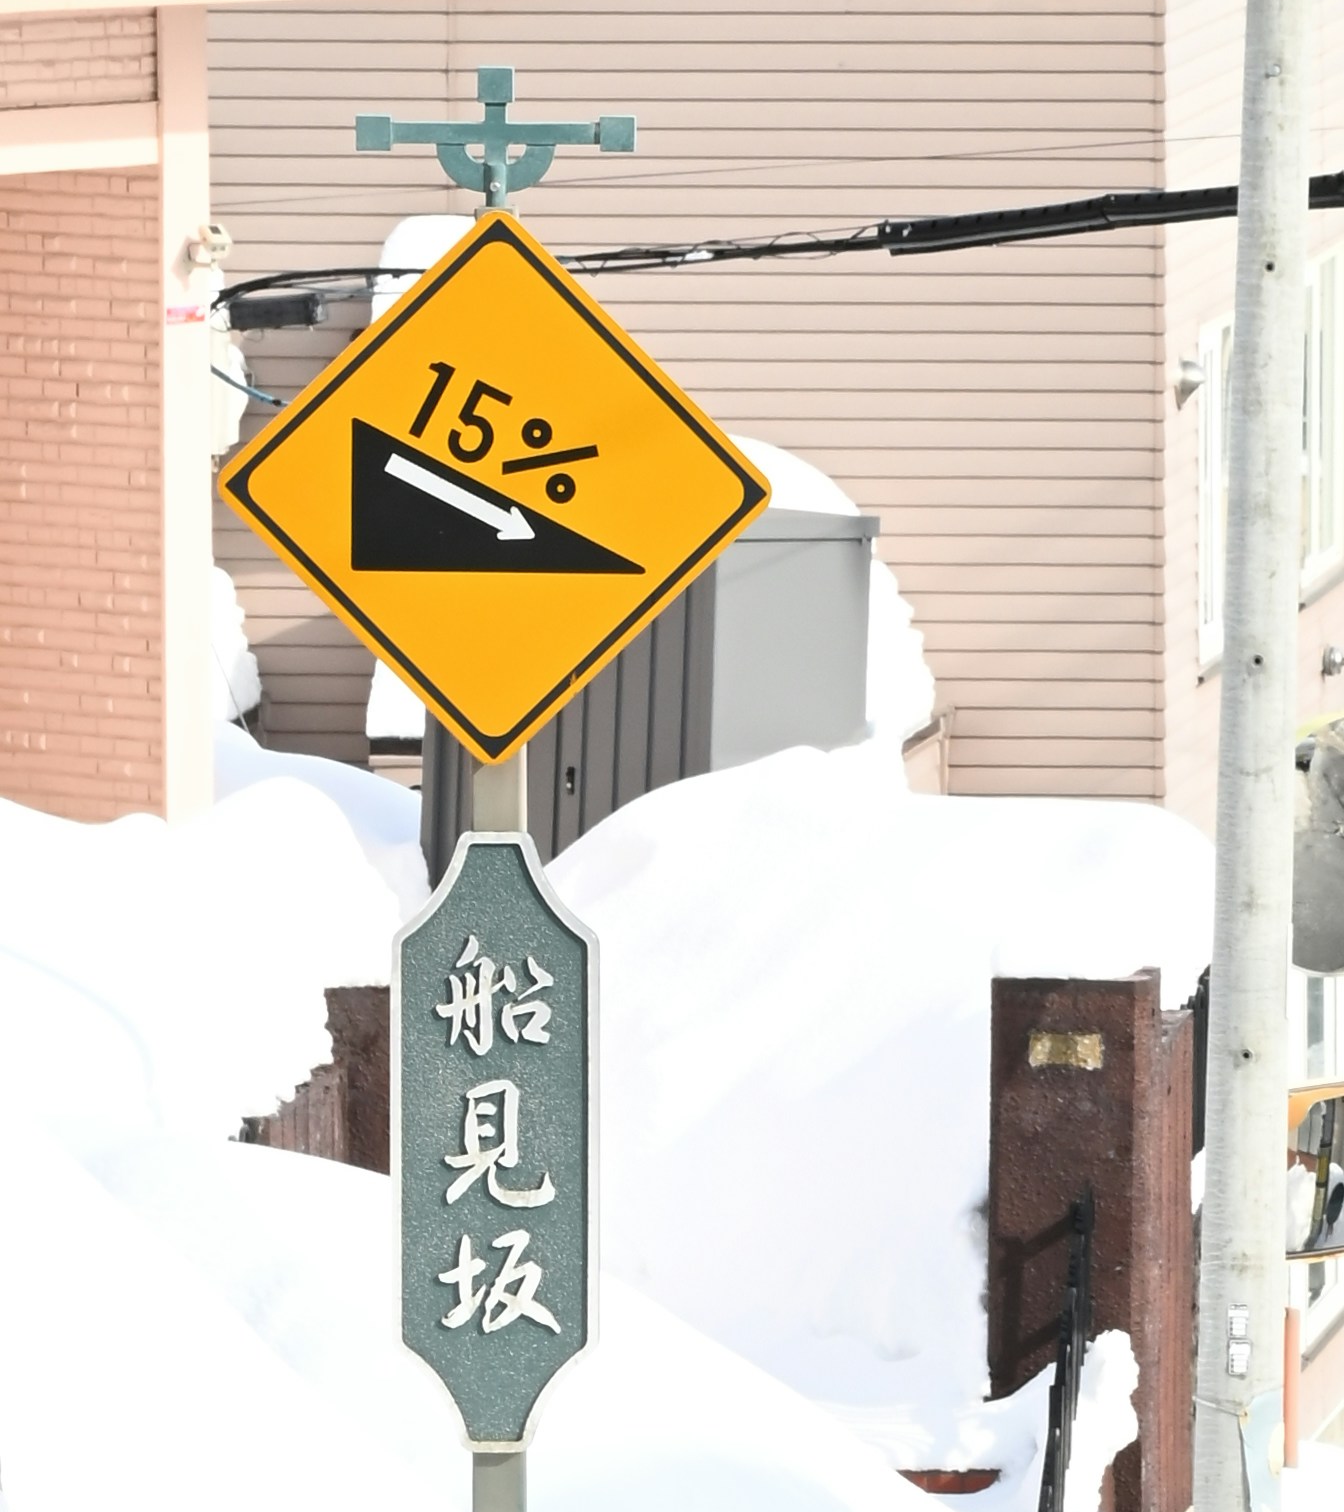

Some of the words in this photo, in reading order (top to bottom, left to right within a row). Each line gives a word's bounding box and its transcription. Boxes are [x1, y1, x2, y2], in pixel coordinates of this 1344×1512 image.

[406, 360, 600, 506] 15%
[435, 933, 562, 1336] 船見坂
